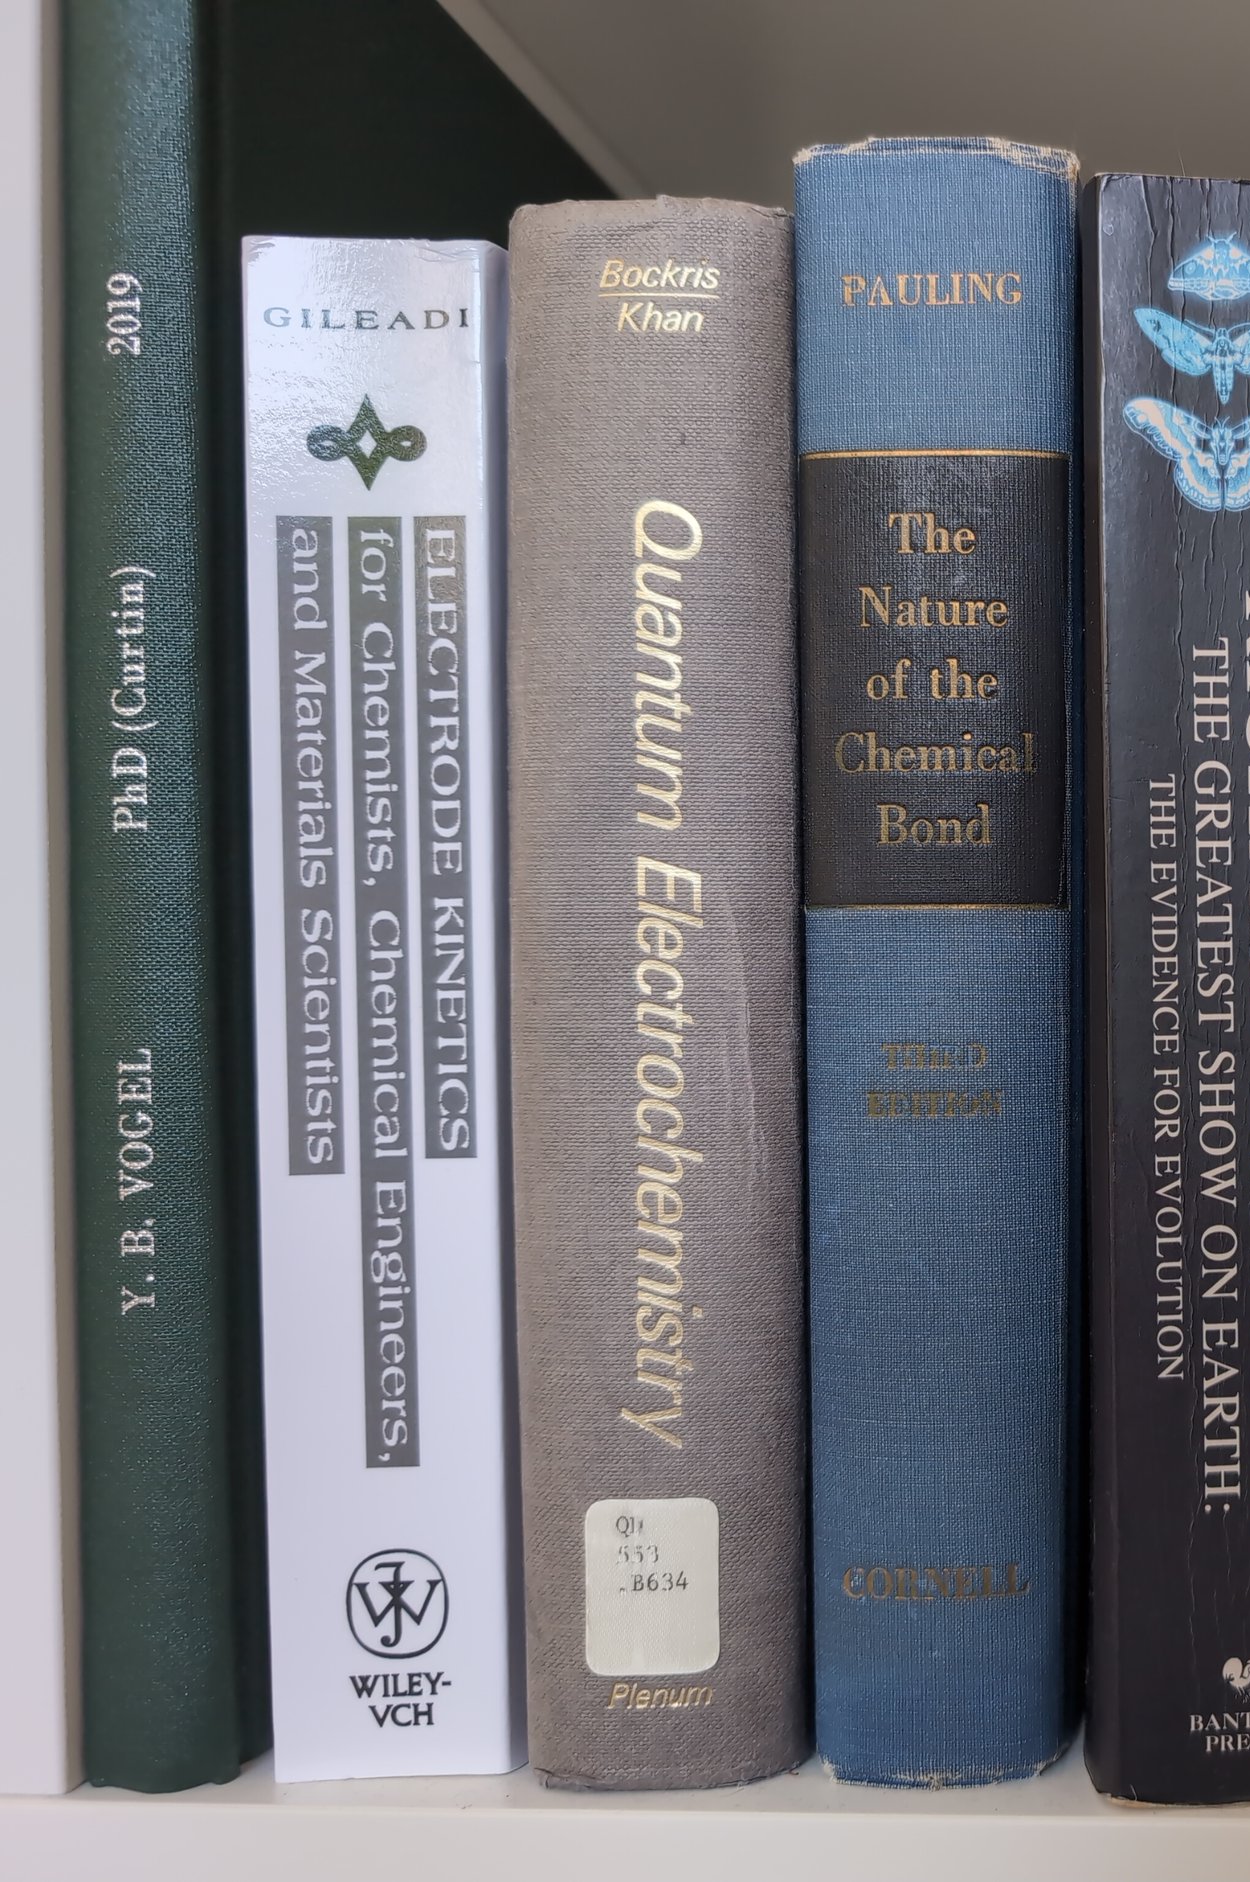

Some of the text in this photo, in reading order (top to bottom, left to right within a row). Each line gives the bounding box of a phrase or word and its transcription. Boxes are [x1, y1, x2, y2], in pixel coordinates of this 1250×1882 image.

[600, 260, 720, 290] Bockris
[841, 272, 1023, 307] PAULING
[106, 272, 143, 357] 2019
[262, 306, 470, 331] GILEADI
[616, 303, 704, 333] Khan
[889, 512, 976, 555] The
[859, 587, 1009, 628] Nature
[109, 566, 159, 832] PhD (Curtin)
[867, 658, 999, 700] of the
[834, 731, 1038, 775] Chemical
[423, 528, 469, 1150] ELECTRODE KINETICS
[876, 803, 991, 846] Bond
[293, 528, 341, 1166] and Materials Scientists
[359, 528, 413, 1462] for Chemists, Chemical Engineers,
[621, 499, 704, 1449] Quantum Electrochemistry
[1149, 773, 1185, 1380] THE EVIDENCE FOR EVOLUTION
[1192, 636, 1243, 1515] THE GREATEST SHOW ON EARTH:
[867, 1089, 1003, 1118] EDITION
[118, 1047, 155, 1315] Y. B. VOGEL
[843, 1563, 1030, 1600] CORNELL
[349, 1671, 452, 1699] WILEY-
[607, 1682, 713, 1709] Plenum
[368, 1702, 435, 1728] VCH
